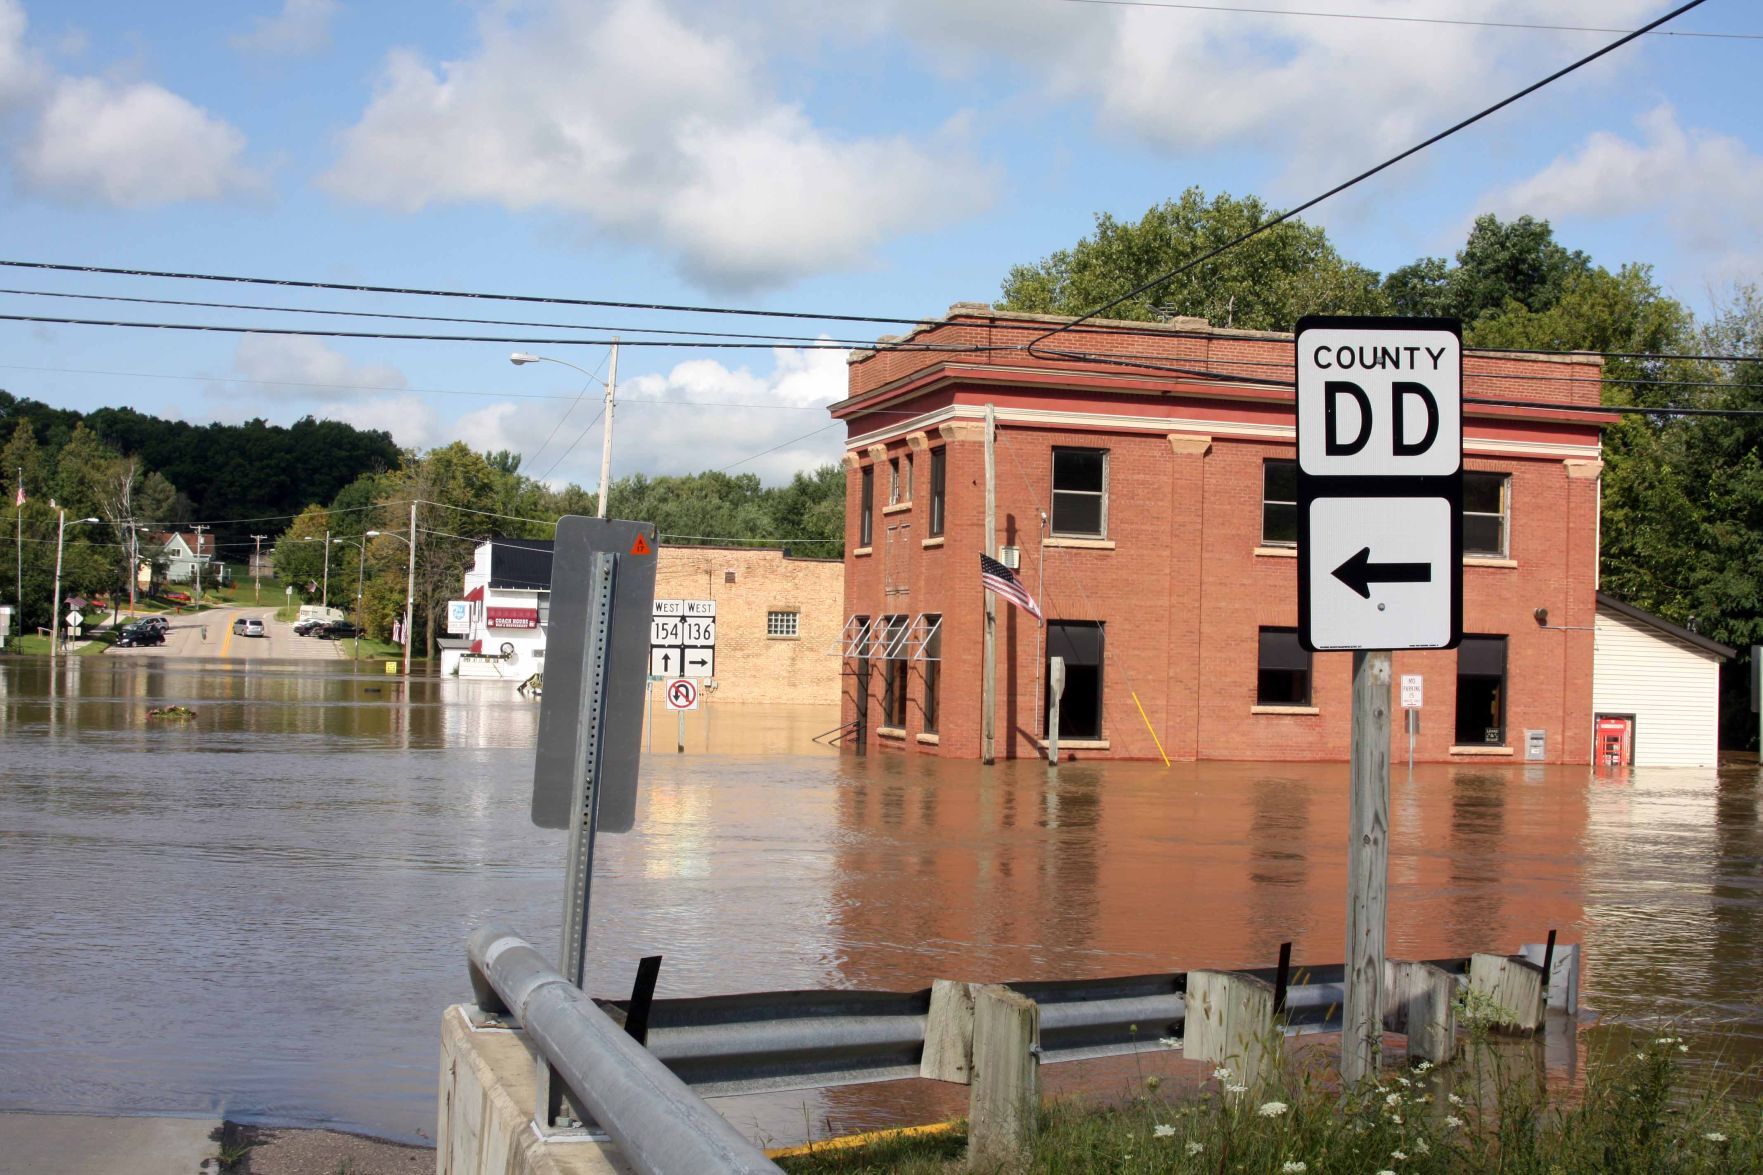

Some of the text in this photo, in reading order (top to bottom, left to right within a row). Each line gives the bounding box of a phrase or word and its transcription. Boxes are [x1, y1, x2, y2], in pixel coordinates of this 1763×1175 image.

[1313, 345, 1446, 370] COUNTY
[655, 602, 680, 612] WEST
[687, 602, 713, 613] WEST
[655, 622, 679, 640] 154
[688, 623, 711, 640] 136
